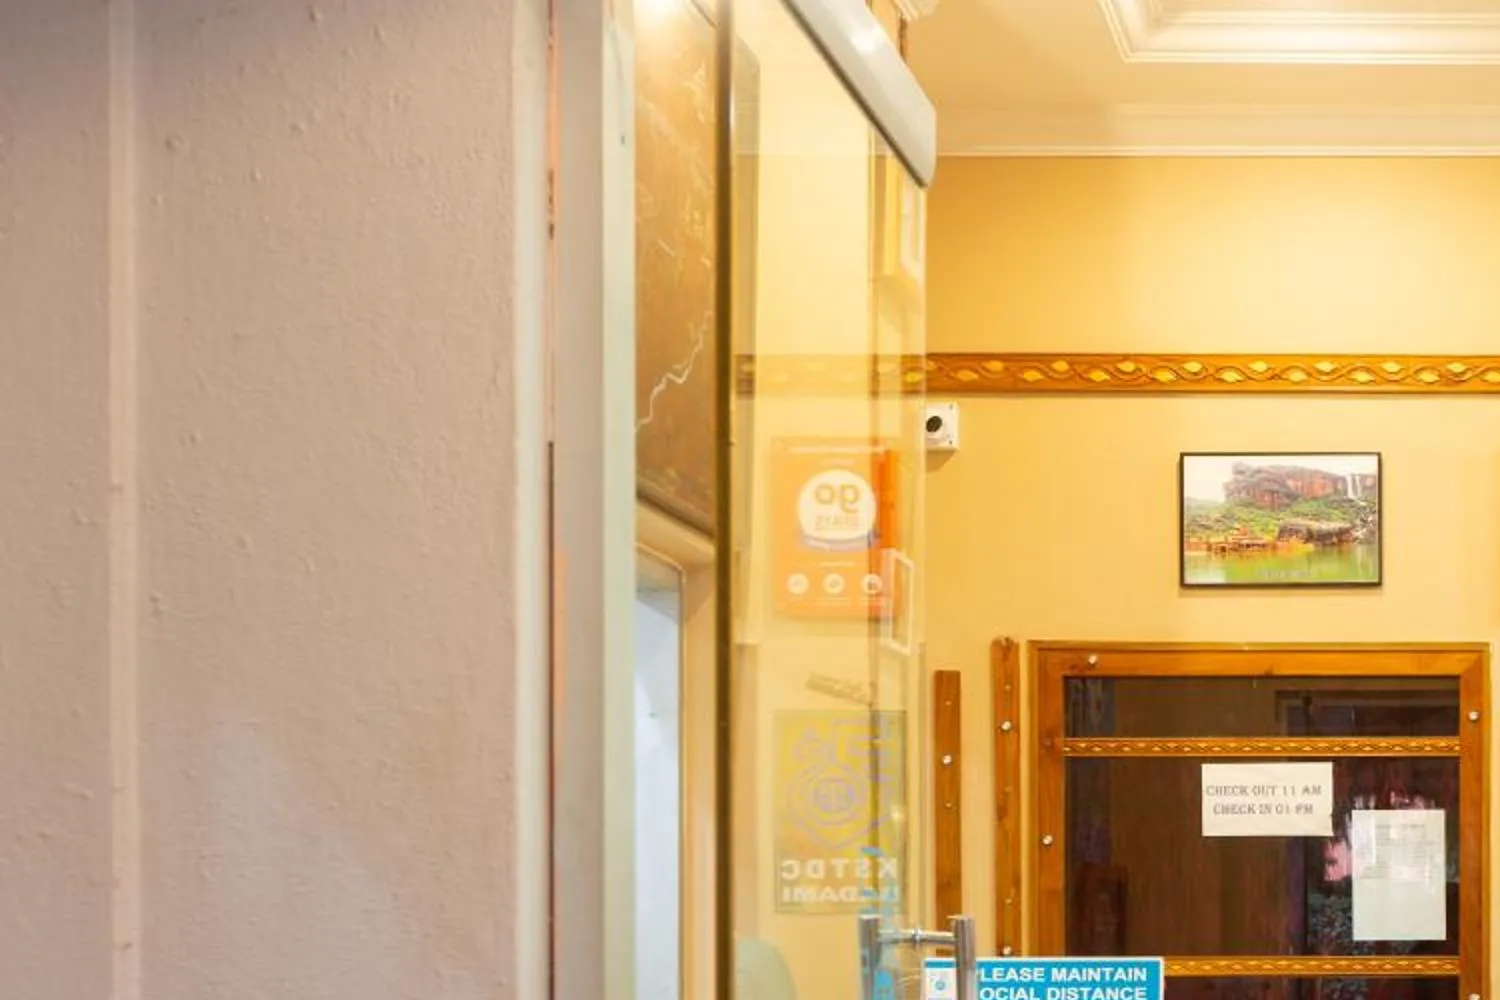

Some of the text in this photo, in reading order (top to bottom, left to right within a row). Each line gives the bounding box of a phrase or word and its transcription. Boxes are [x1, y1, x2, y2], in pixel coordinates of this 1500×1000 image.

[1205, 785, 1249, 797] CHECK
[1251, 785, 1278, 797] OUT
[1302, 785, 1322, 797] AM
[1213, 803, 1257, 815] CHECK
[978, 967, 1148, 983] LEASE MAINTAIN
